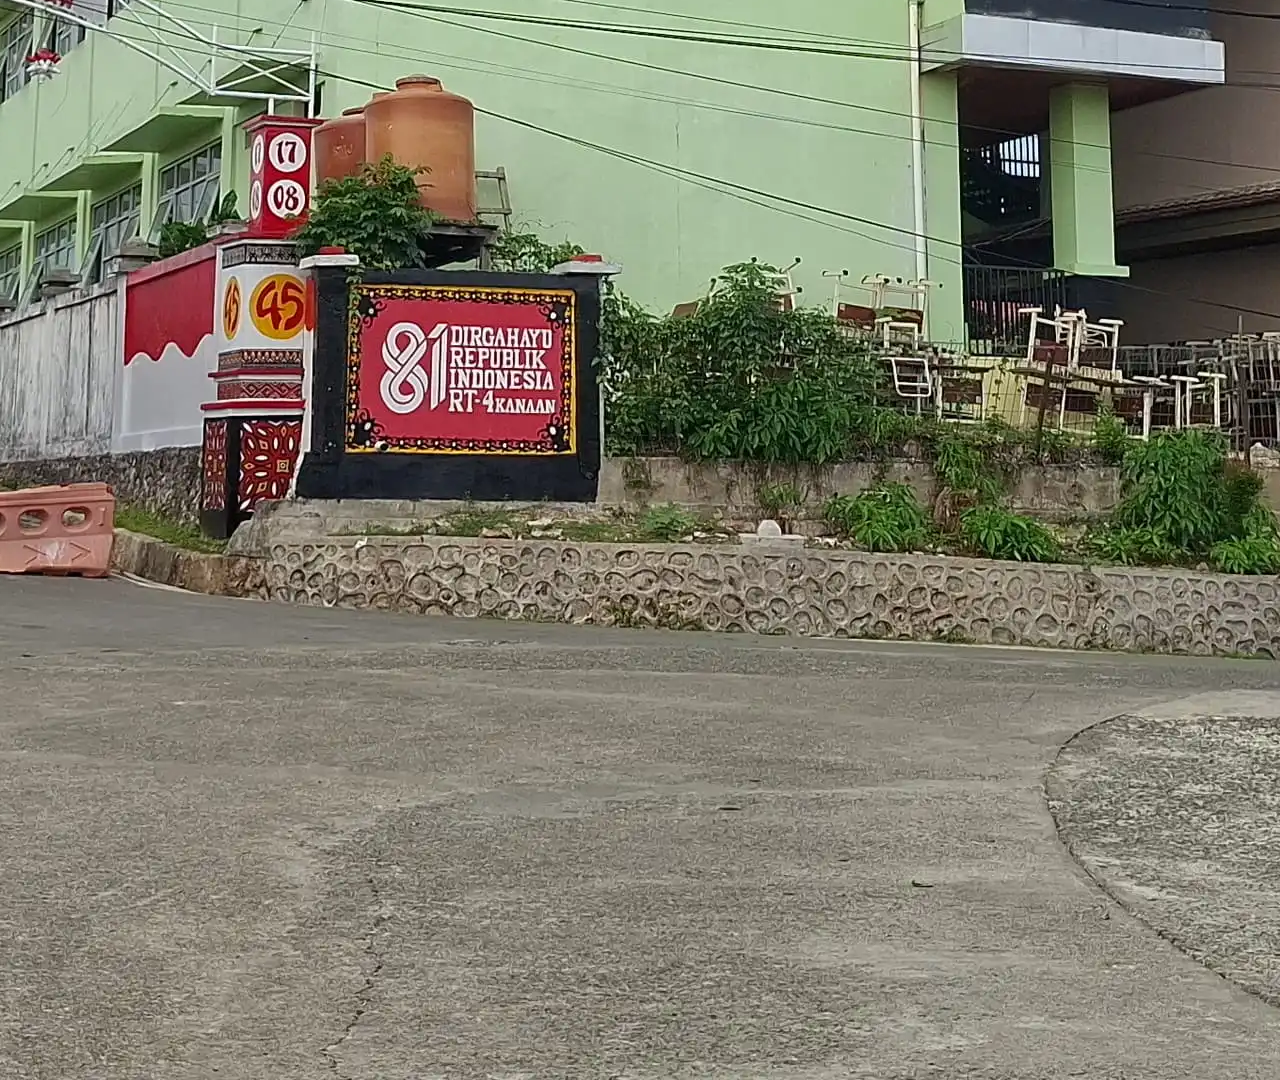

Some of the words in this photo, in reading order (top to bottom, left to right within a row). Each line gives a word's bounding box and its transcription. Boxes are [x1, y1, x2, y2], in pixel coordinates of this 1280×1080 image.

[275, 140, 297, 165] 17
[273, 185, 299, 212] 08
[255, 280, 304, 331] 45
[450, 326, 553, 348] DIRGAHAYU
[380, 322, 448, 414] 81
[450, 347, 547, 369] REPUBLIK
[449, 369, 554, 390] INDONESIA
